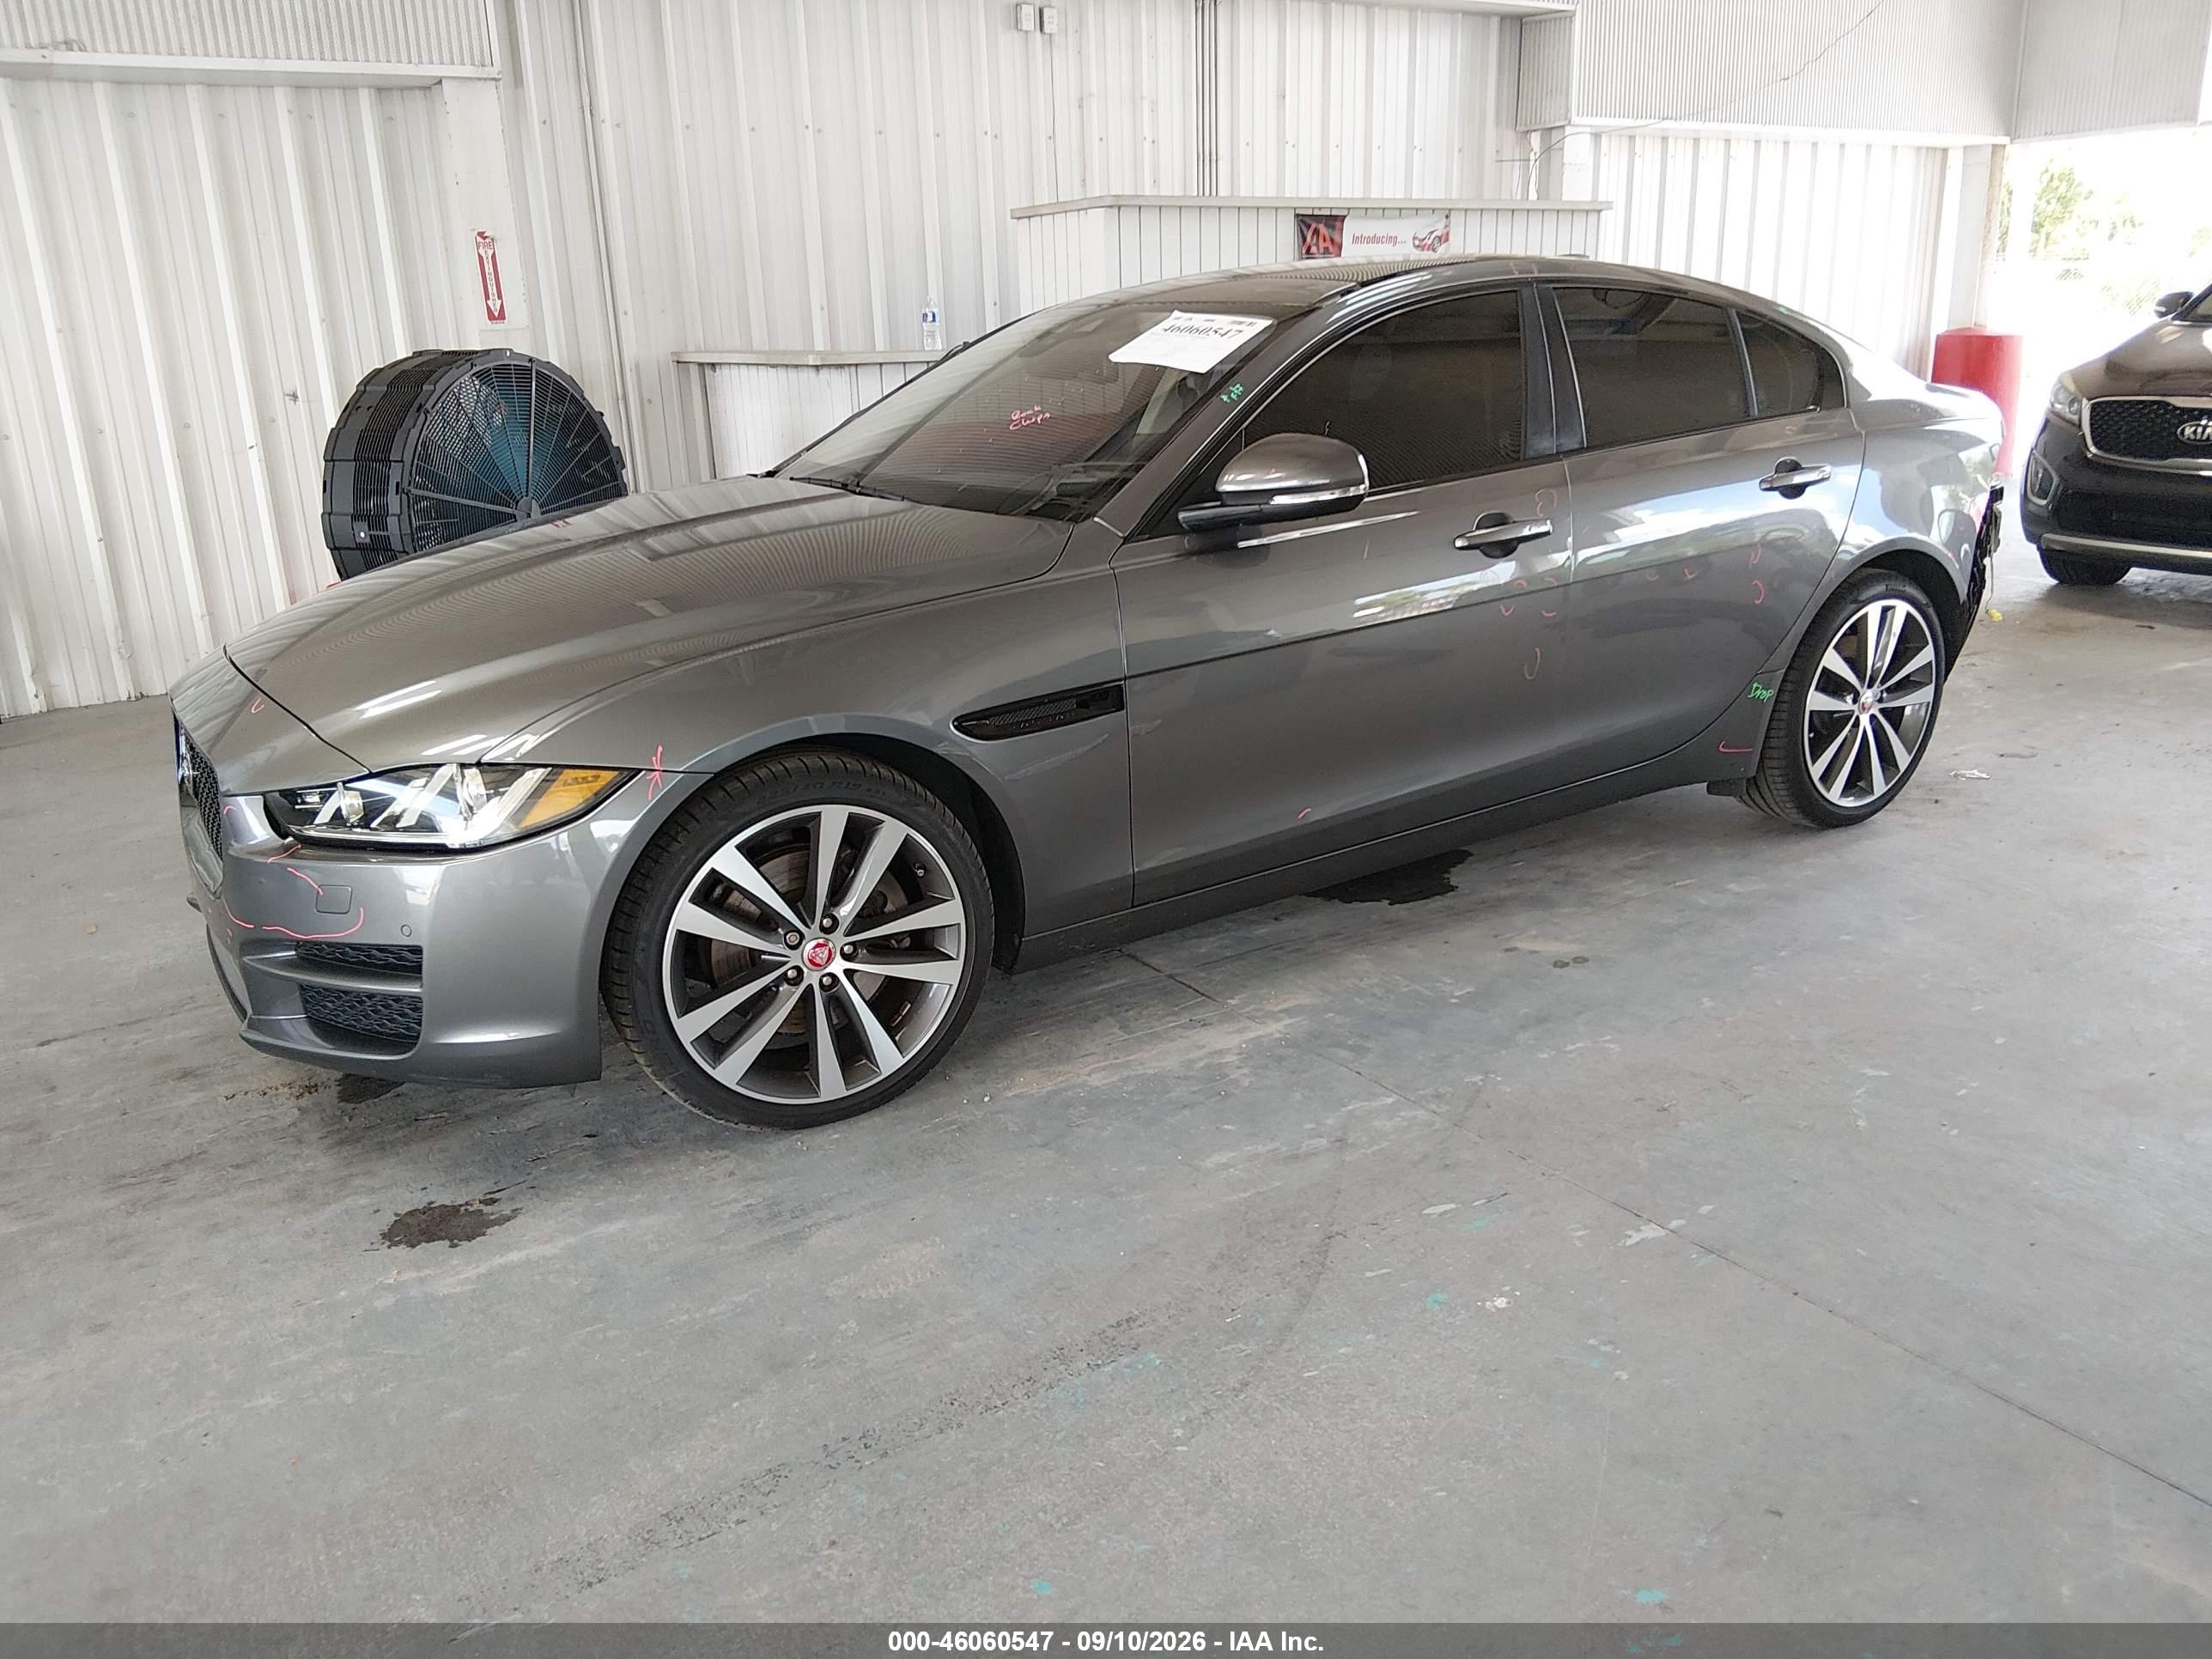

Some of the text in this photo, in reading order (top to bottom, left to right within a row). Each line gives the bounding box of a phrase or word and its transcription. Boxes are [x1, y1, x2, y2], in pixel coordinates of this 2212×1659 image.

[477, 240, 494, 250] FIRE
[1352, 232, 1407, 246] Introducing...
[484, 250, 498, 313] EXTINGUISHER
[1162, 324, 1244, 339] 46060547
